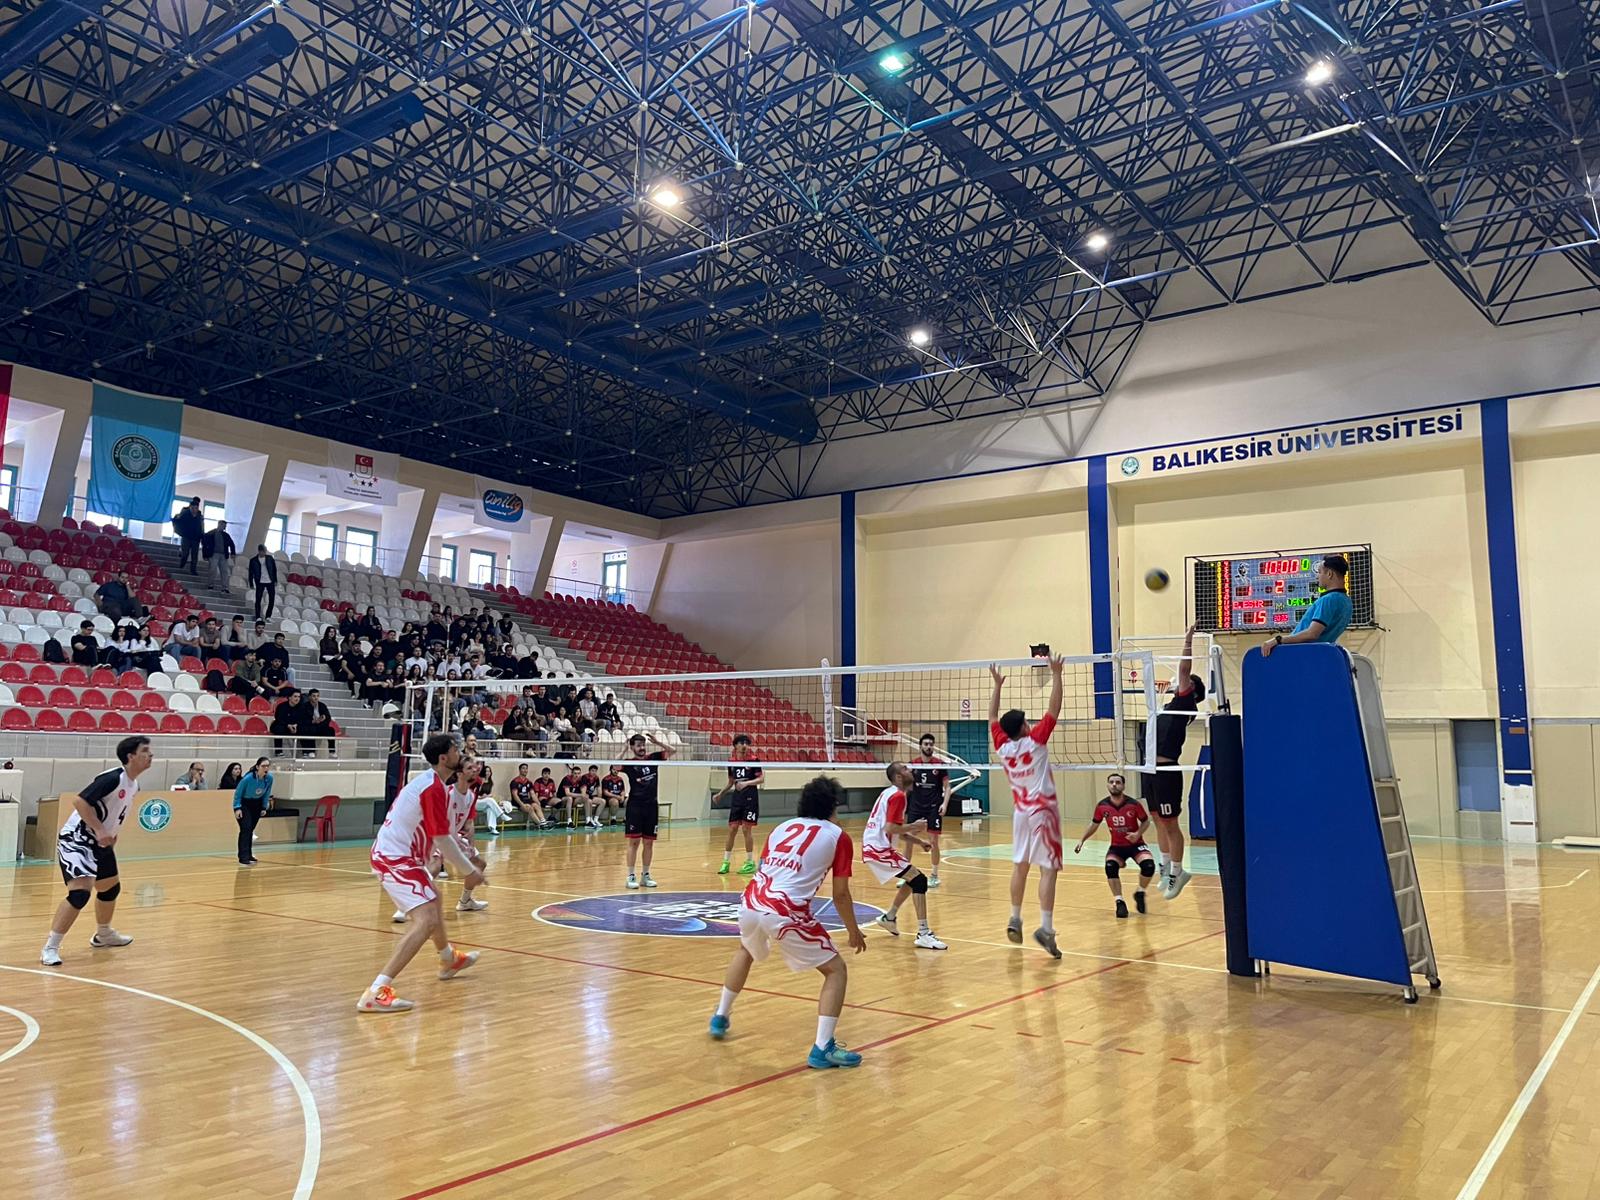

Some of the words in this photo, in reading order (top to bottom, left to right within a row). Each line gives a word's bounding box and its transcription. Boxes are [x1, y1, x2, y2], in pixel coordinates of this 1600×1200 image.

[1152, 437, 1272, 471] BALIKESİR
[1277, 408, 1462, 454] ÜNİVERSİTESİ
[1275, 580, 1284, 593] 2
[736, 769, 745, 777] 24
[921, 773, 927, 783] 5
[1160, 803, 1172, 815] 10
[746, 811, 756, 821] 24
[1112, 816, 1126, 826] 99
[774, 823, 822, 857] 21
